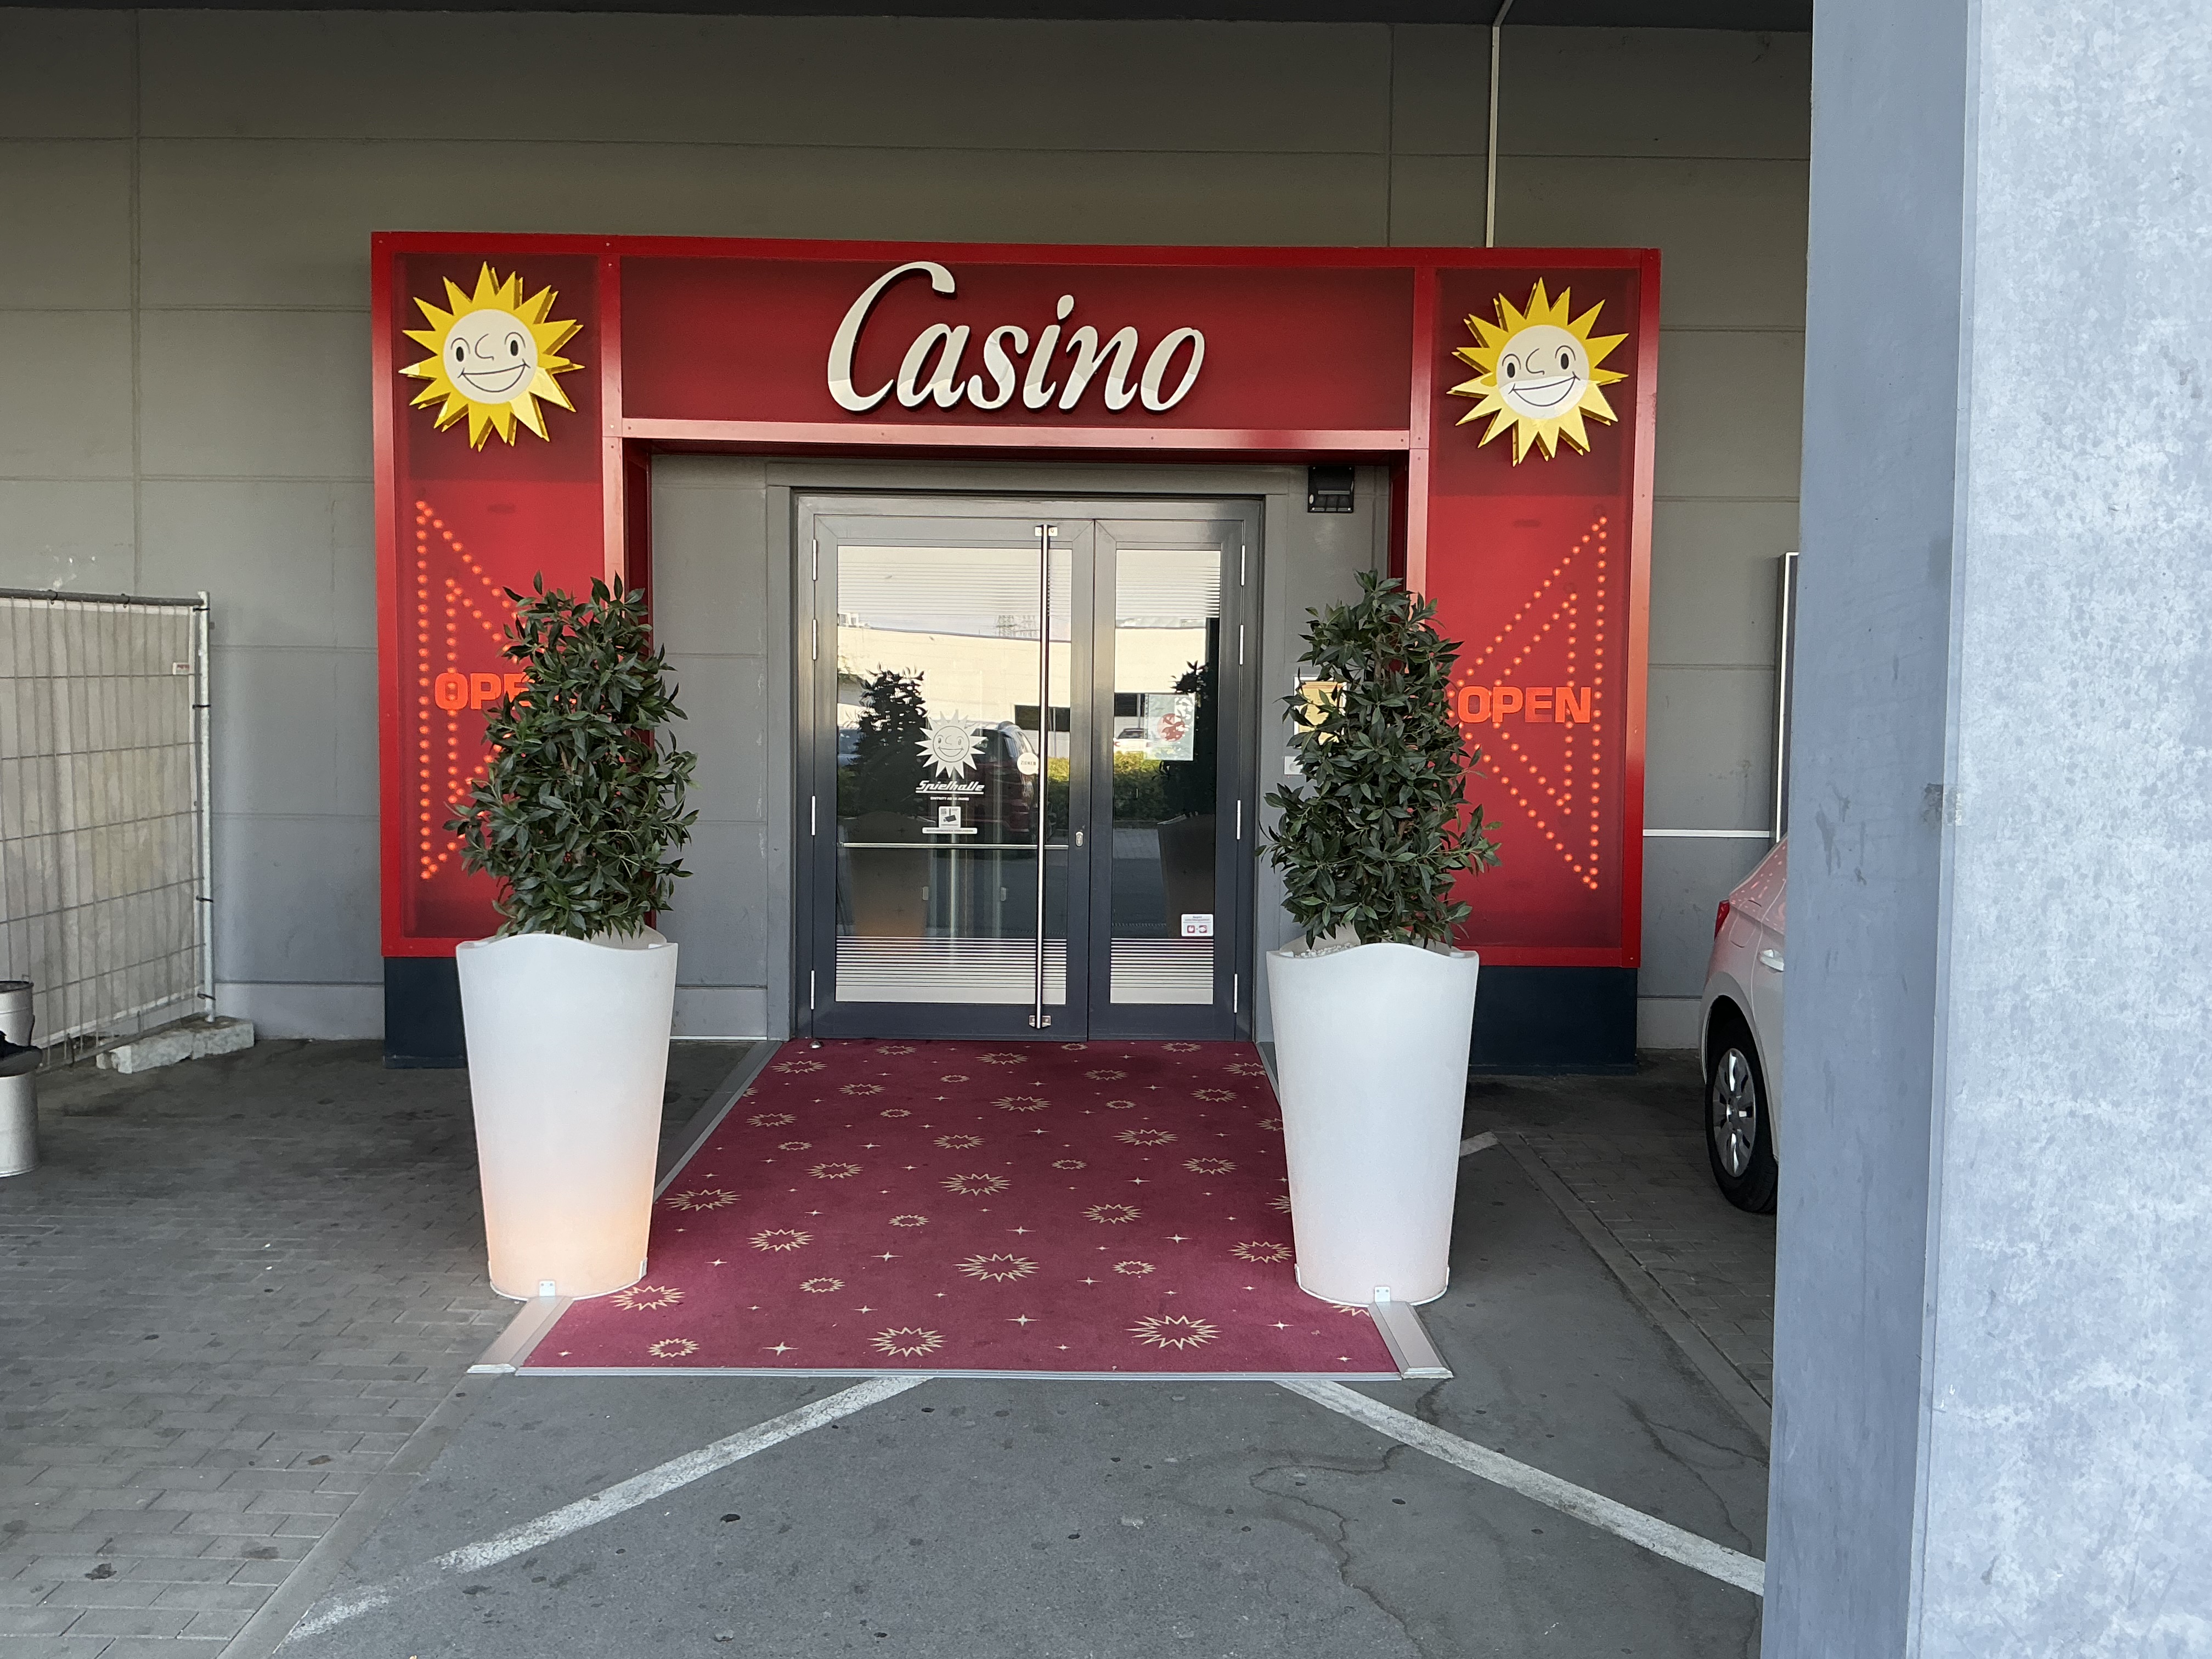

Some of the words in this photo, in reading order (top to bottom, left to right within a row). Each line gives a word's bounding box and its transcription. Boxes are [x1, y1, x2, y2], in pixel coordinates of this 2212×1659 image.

[827, 261, 1205, 411] Casino
[435, 672, 537, 710] OPE
[1457, 686, 1591, 724] OPEN
[915, 780, 985, 792] Spielhalle
